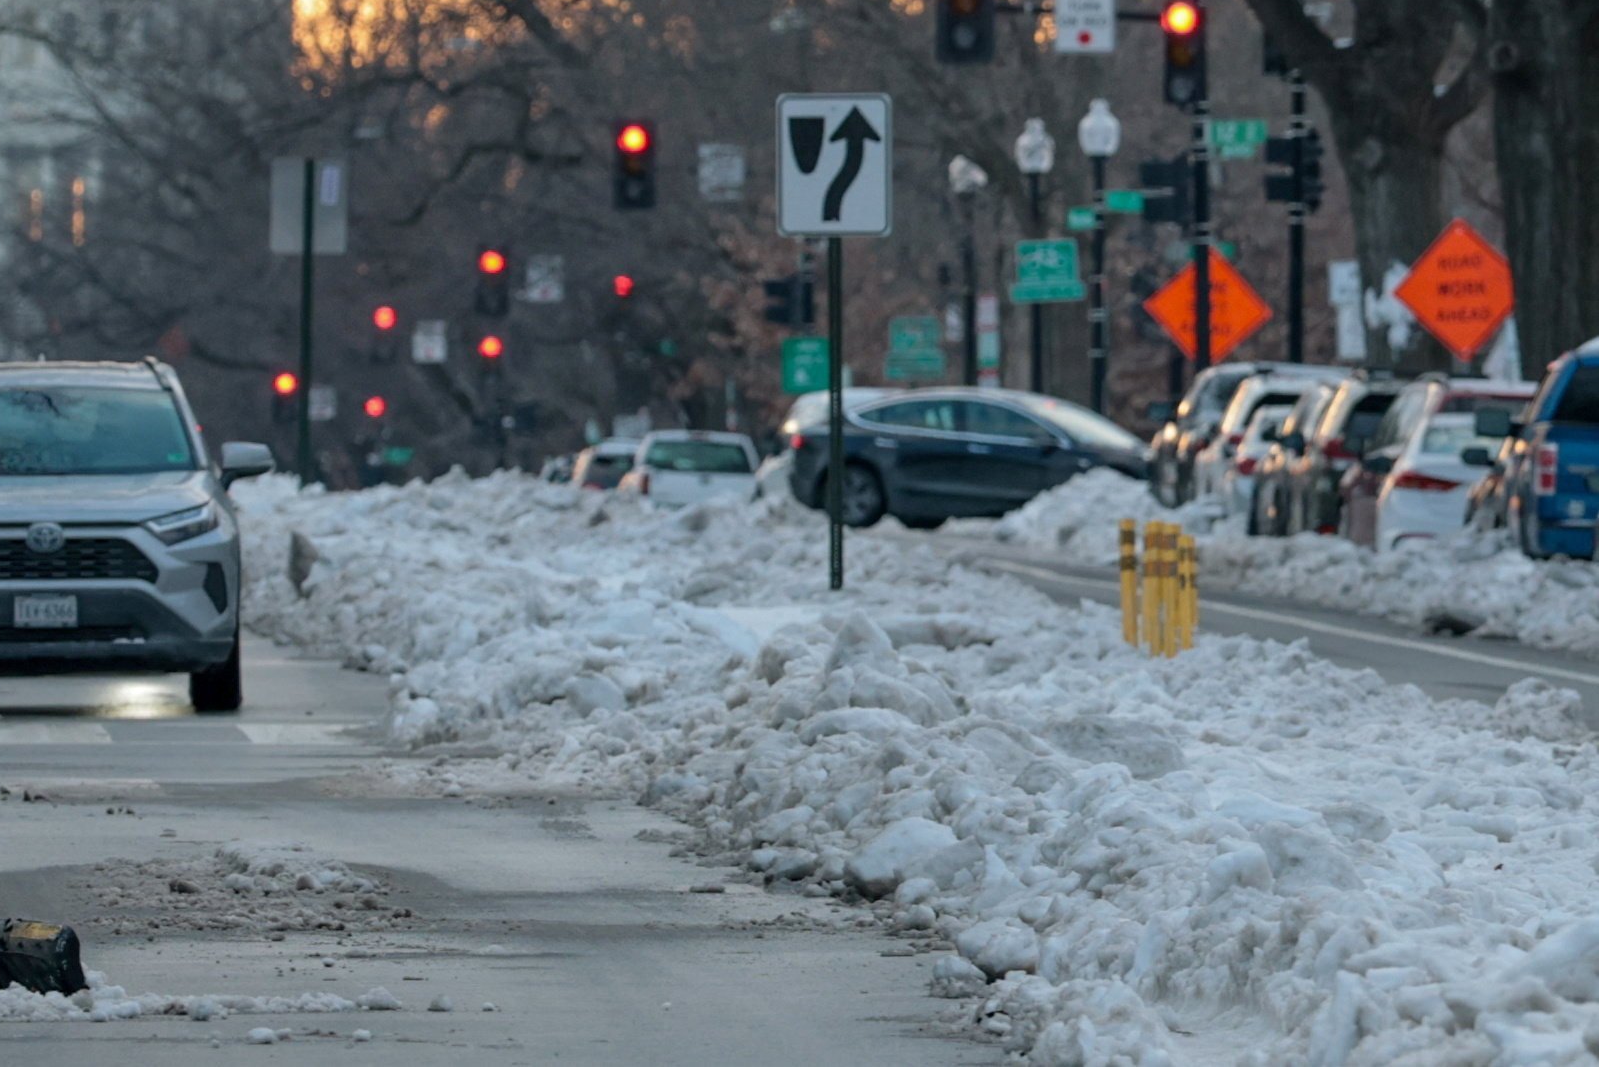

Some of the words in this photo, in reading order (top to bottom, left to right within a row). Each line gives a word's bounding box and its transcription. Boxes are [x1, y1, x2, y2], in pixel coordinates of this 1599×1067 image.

[1437, 255, 1483, 270] ROAD
[1437, 280, 1487, 295] WORK
[1436, 307, 1492, 322] AHEAD
